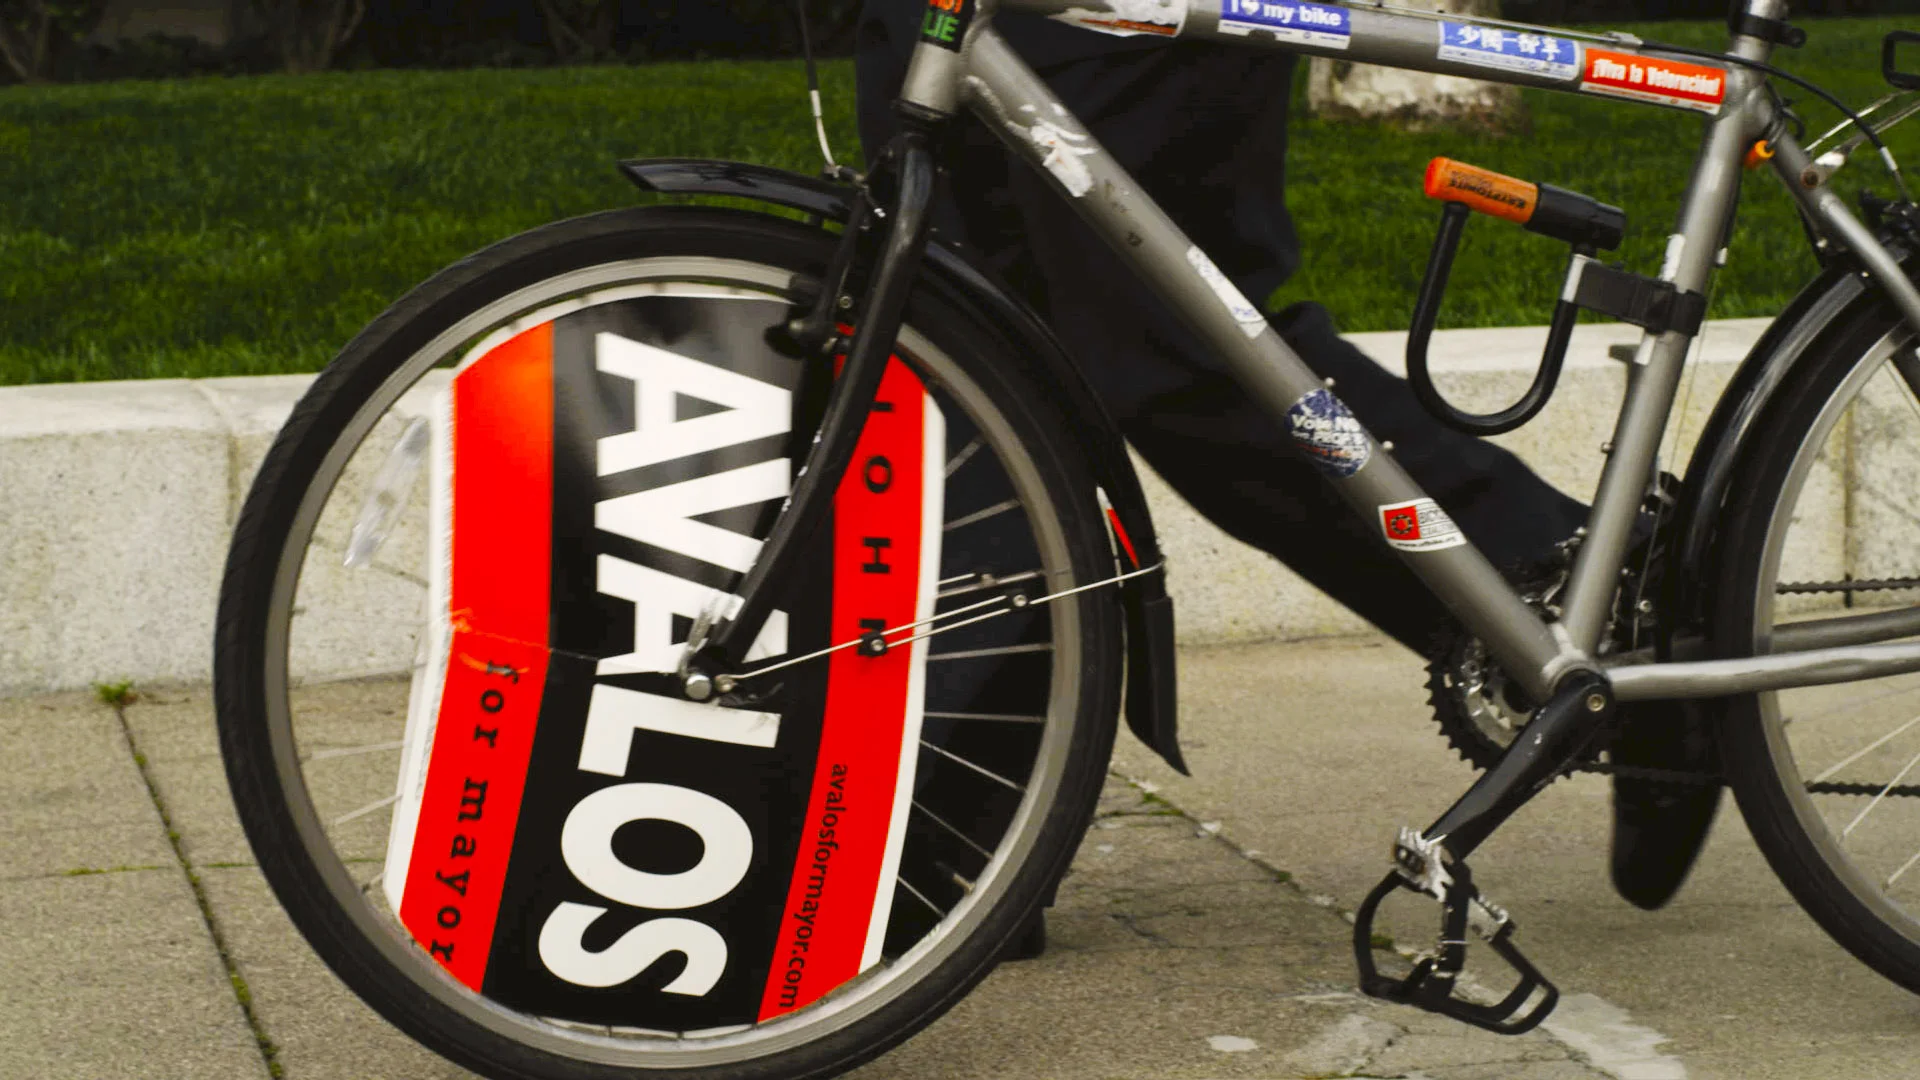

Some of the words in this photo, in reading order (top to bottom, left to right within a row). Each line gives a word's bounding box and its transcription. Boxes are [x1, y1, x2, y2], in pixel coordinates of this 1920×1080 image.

[1263, 3, 1294, 24] my
[1299, 5, 1342, 26] bike
[473, 660, 520, 748] for
[538, 331, 793, 997] AVALOS
[430, 777, 489, 962] mayor
[779, 763, 848, 1008] avalosformayor.com
